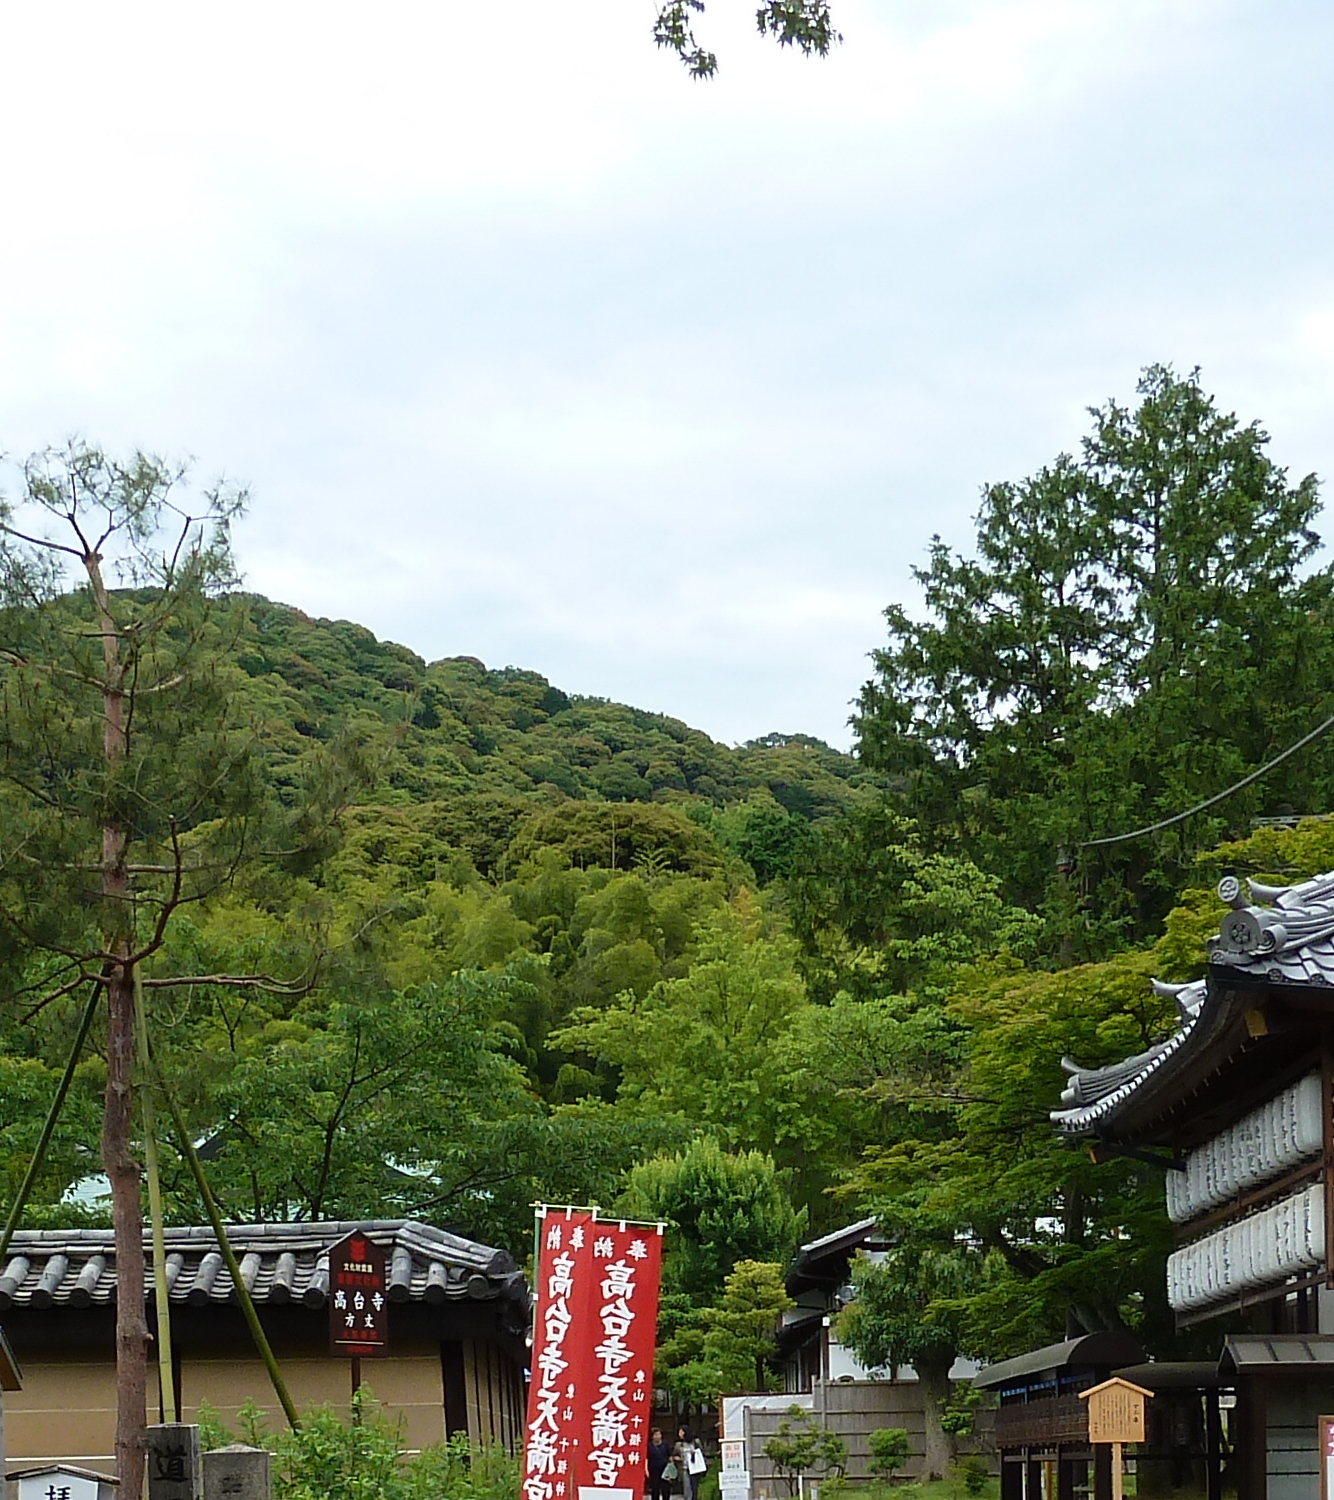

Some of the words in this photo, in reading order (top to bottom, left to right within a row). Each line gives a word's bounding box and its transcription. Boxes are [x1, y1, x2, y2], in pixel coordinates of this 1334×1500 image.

[334, 1290, 384, 1312] 高台寺
[344, 1312, 375, 1328] 方丈
